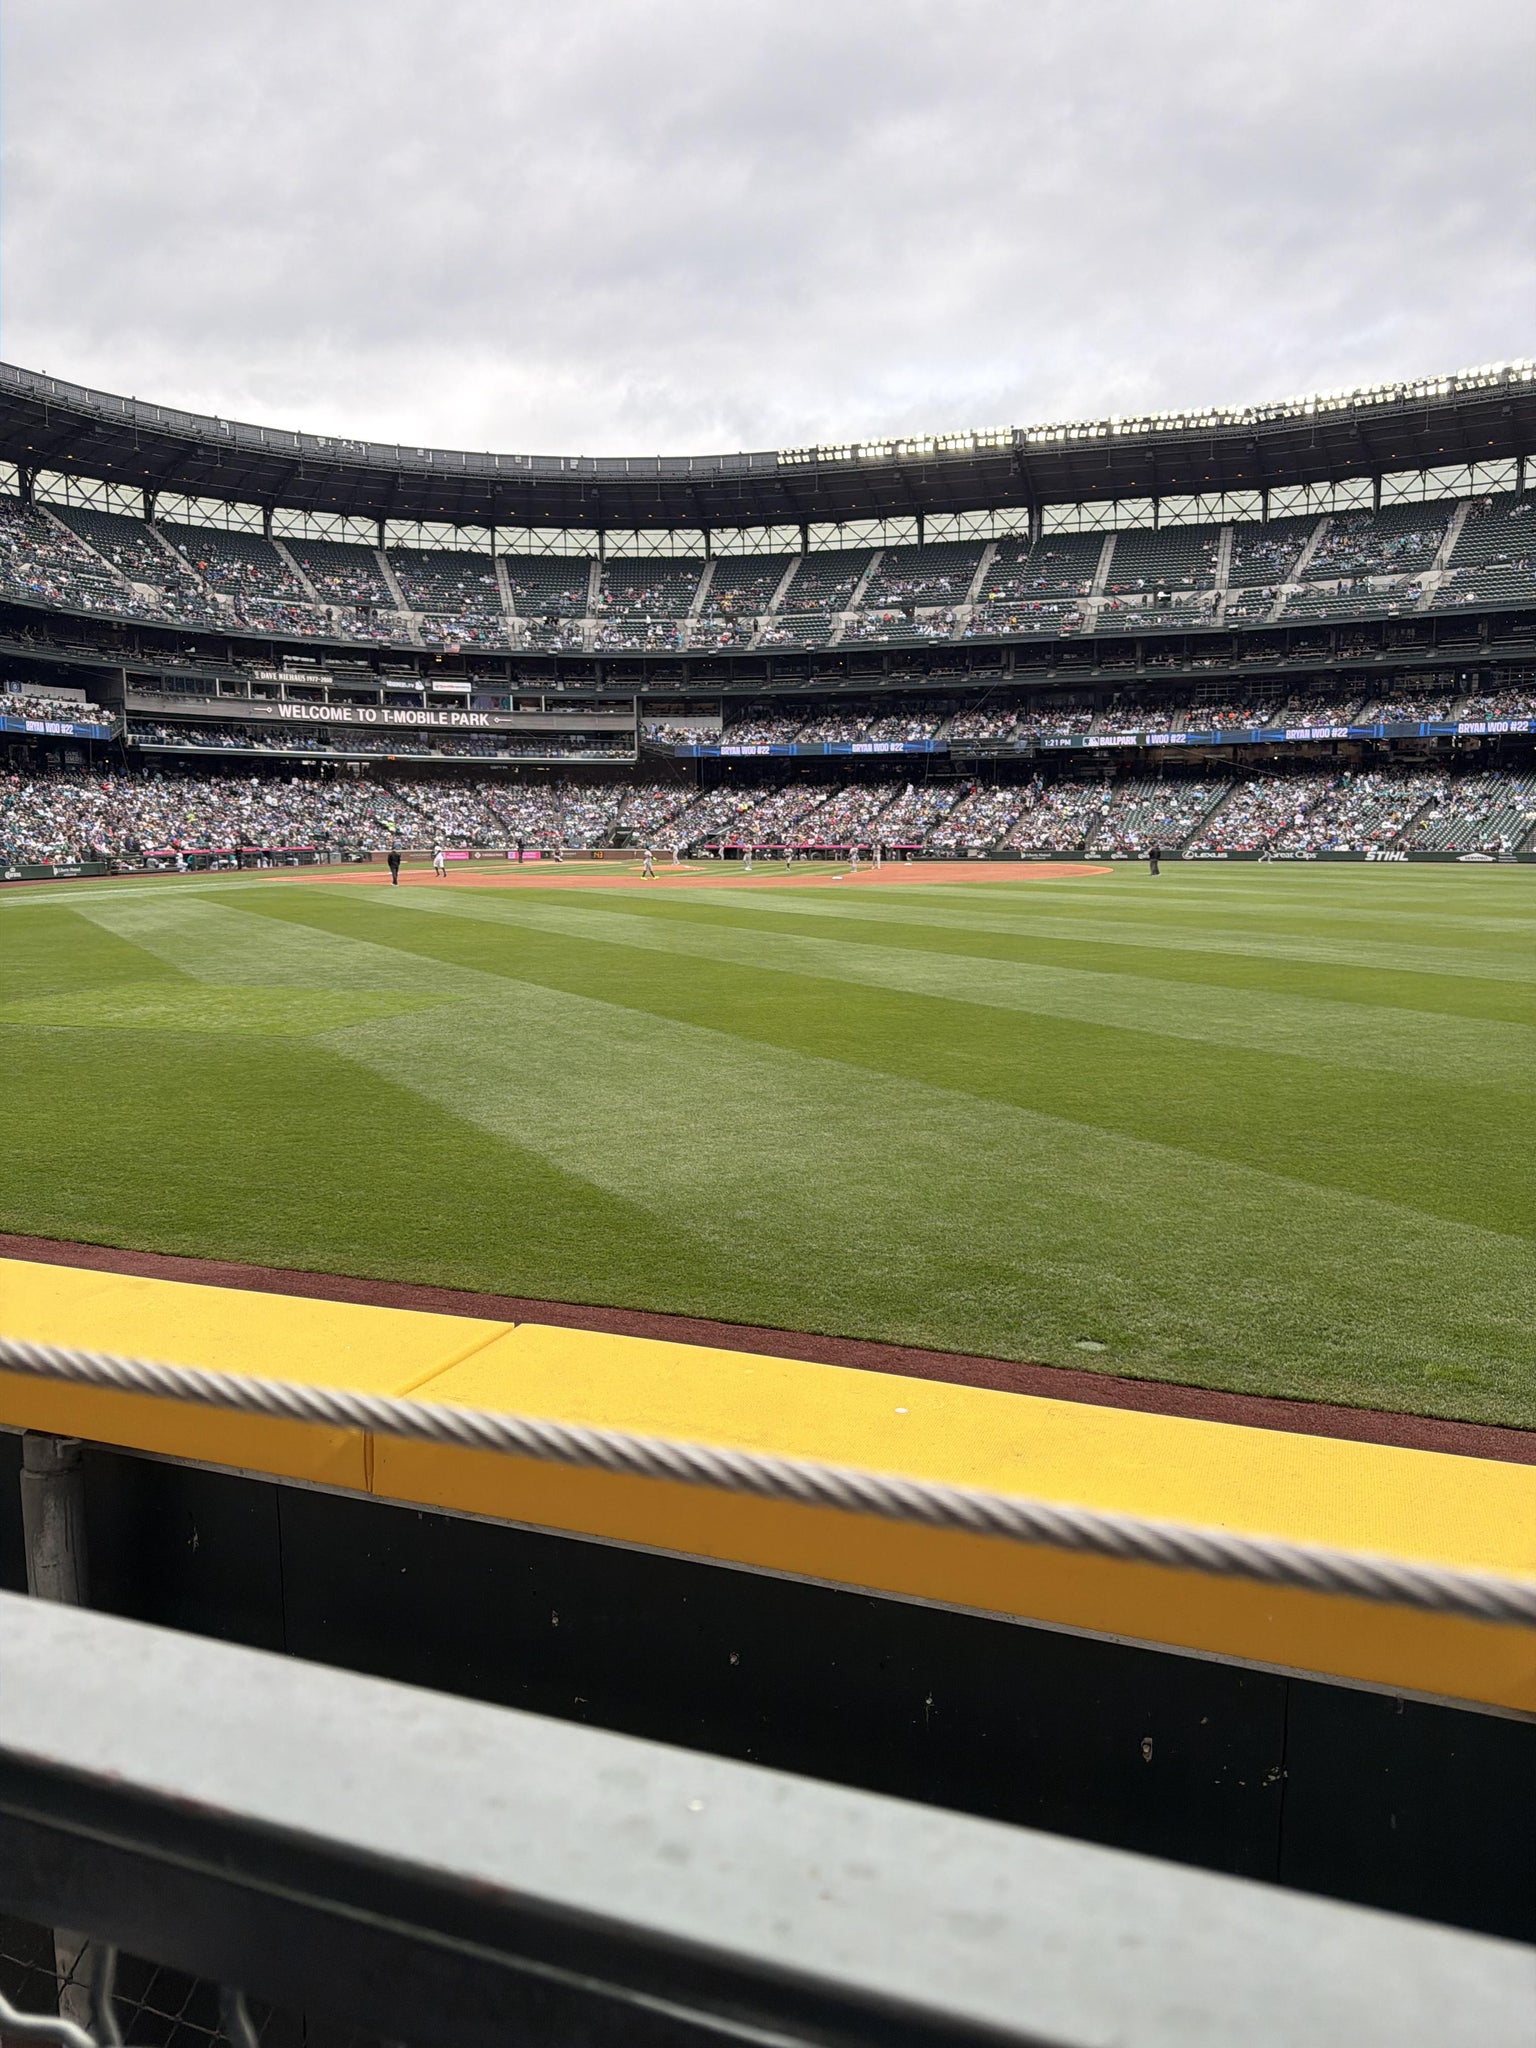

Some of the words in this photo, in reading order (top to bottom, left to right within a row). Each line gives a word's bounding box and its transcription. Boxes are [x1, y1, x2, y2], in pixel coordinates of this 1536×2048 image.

[260, 671, 277, 680] DAVE
[278, 704, 352, 721] WELCOME
[356, 708, 377, 722] TO
[381, 709, 448, 725] T-MOBILE
[451, 711, 490, 726] PARK
[45, 721, 60, 733] WOO
[61, 723, 74, 735] #22
[1458, 722, 1486, 734] BRYAN
[1487, 721, 1508, 732] WOO
[1510, 721, 1529, 732] #22
[1286, 729, 1311, 739] BRYAN
[1311, 728, 1330, 738] WOO
[1331, 727, 1348, 738] #22
[1060, 738, 1071, 746] PM
[1100, 736, 1137, 745] BALLPARK
[1151, 734, 1169, 744] WOO
[1170, 733, 1186, 743] #22
[721, 746, 741, 755] BRYAN
[741, 746, 757, 755] WOO
[757, 746, 770, 754] #22
[852, 743, 872, 752] BRYAN
[873, 743, 890, 752] WOO
[890, 742, 904, 752] #22
[1295, 850, 1317, 860] Clips
[1365, 851, 1408, 861] STIHL
